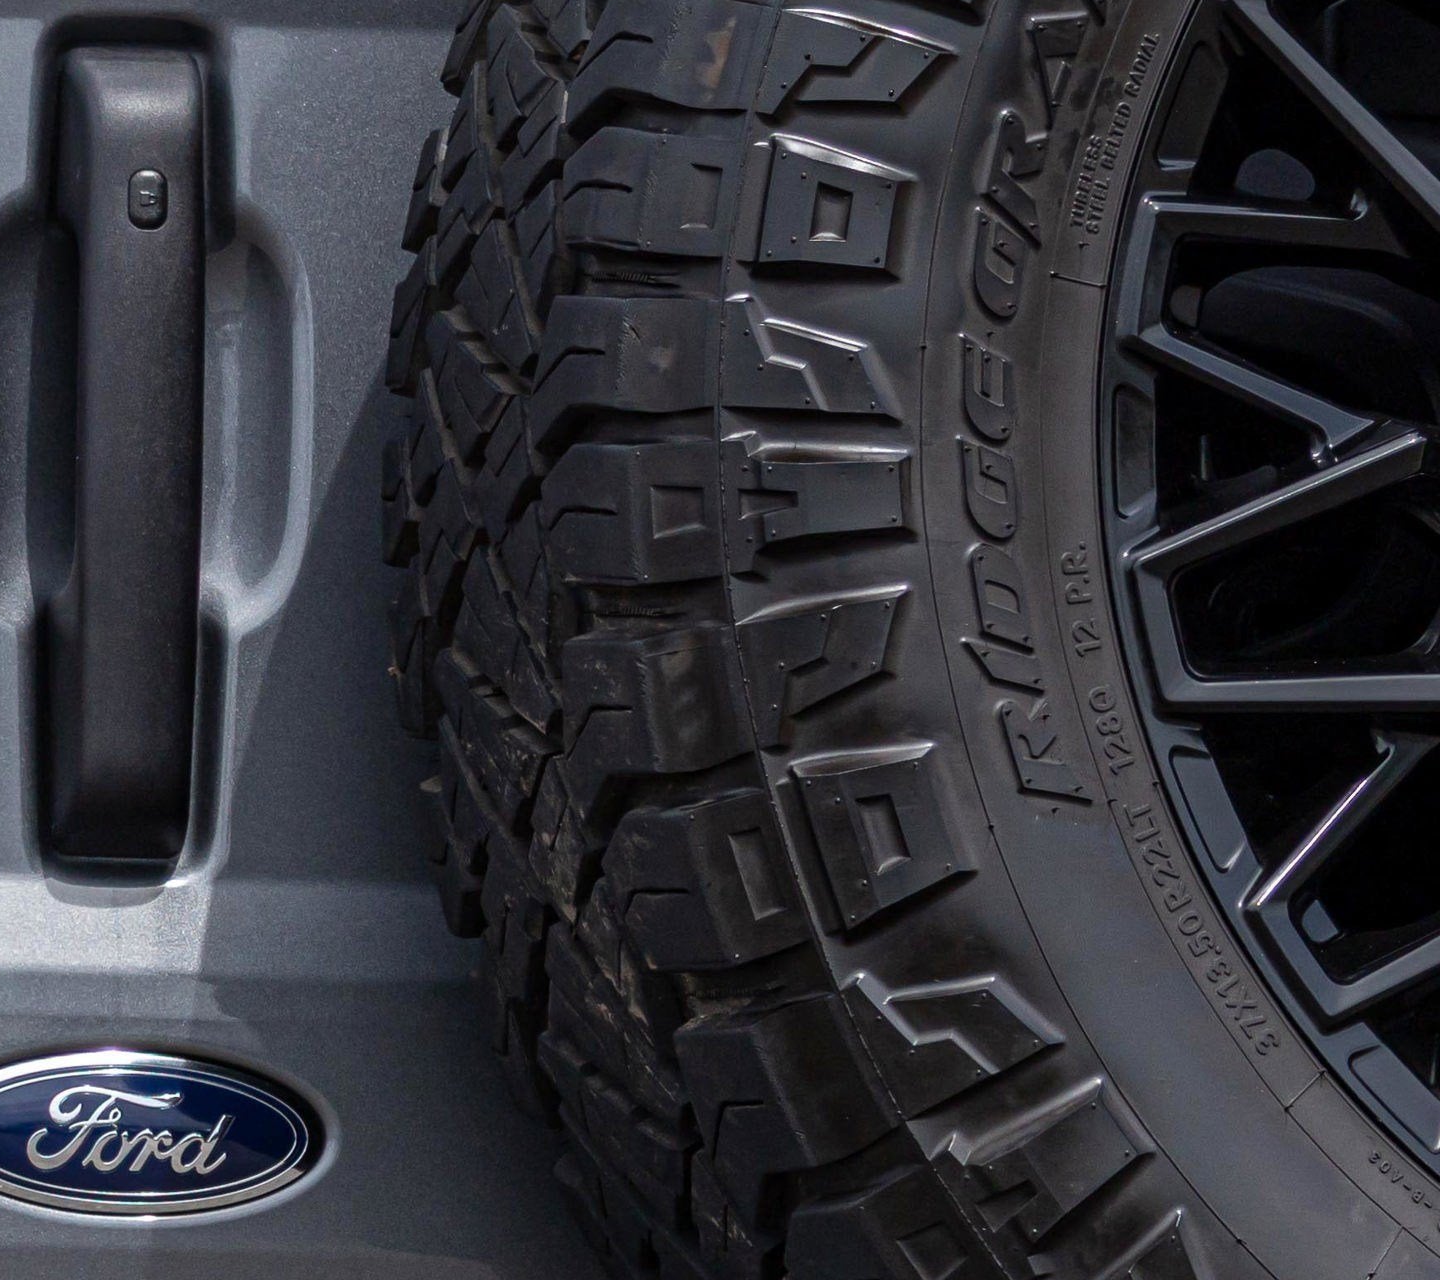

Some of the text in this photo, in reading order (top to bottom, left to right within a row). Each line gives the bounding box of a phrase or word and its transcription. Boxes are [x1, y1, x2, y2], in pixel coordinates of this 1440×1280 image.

[1123, 32, 1160, 98] RADIAL
[959, 334, 1094, 802] RIDGE
[26, 1082, 236, 1175] Ford
